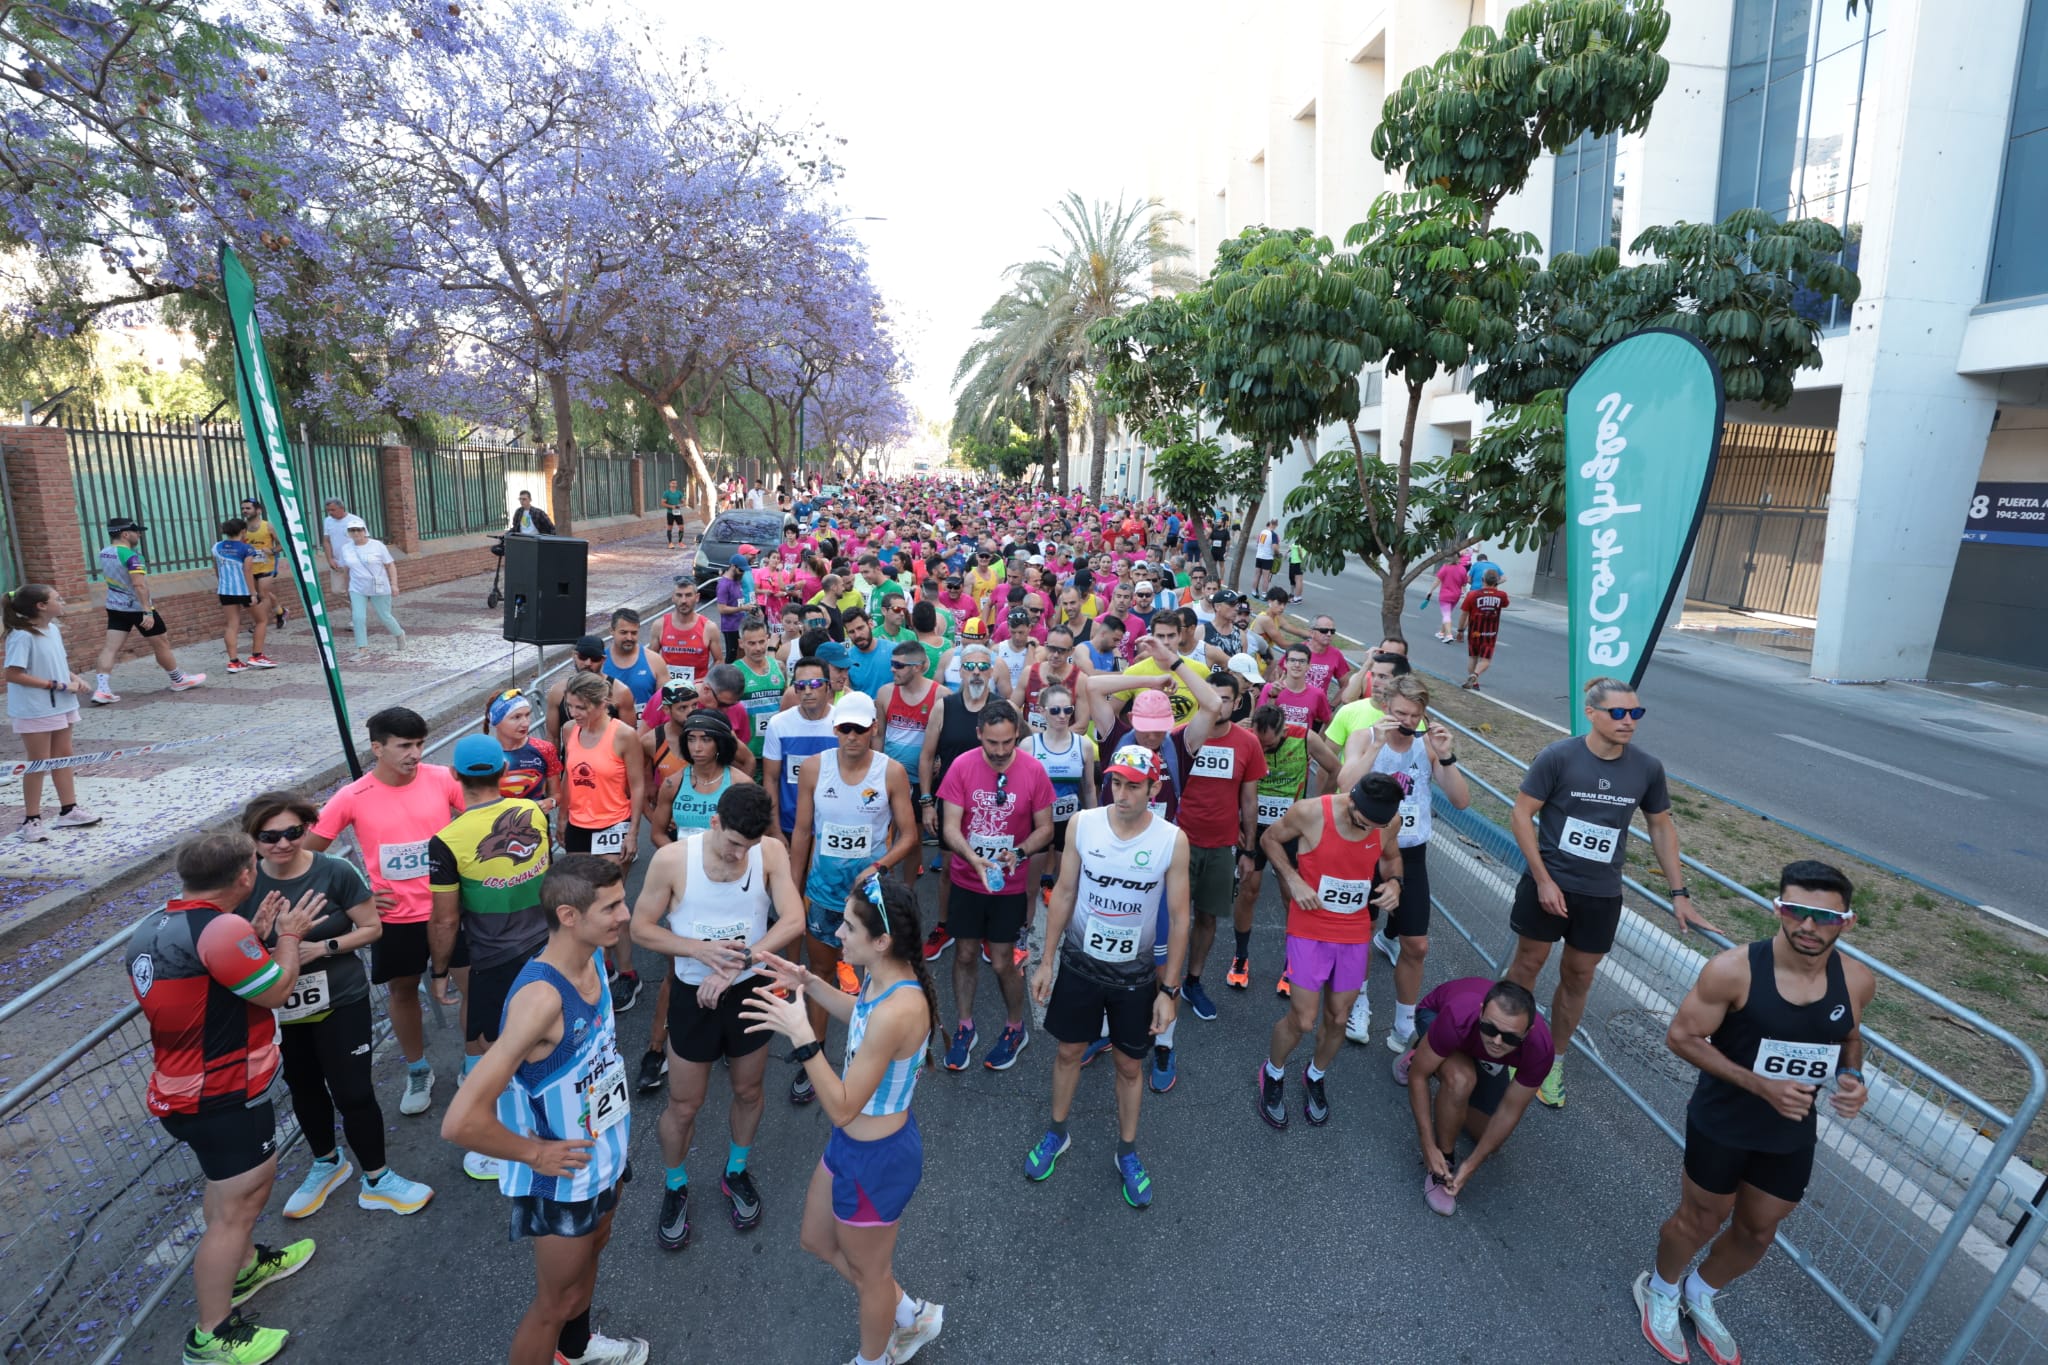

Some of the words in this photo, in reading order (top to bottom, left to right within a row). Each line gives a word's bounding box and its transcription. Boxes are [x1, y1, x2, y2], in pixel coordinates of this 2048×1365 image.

[1997, 497, 2039, 508] PUERTA
[1996, 510, 2046, 521] 1942-2002
[1195, 755, 1230, 770] 690
[1570, 791, 1597, 799] URBAN
[672, 801, 718, 815] nerja
[1258, 804, 1290, 818] 683
[827, 834, 867, 850] 334
[1568, 831, 1612, 854] 696
[482, 876, 506, 889] LOS
[507, 851, 548, 888] CHAKALE
[1088, 891, 1143, 914] PRIMOR
[1323, 888, 1364, 905] 294
[1089, 932, 1134, 954] 278
[1764, 1055, 1829, 1079] 668
[597, 1080, 627, 1120] 21
